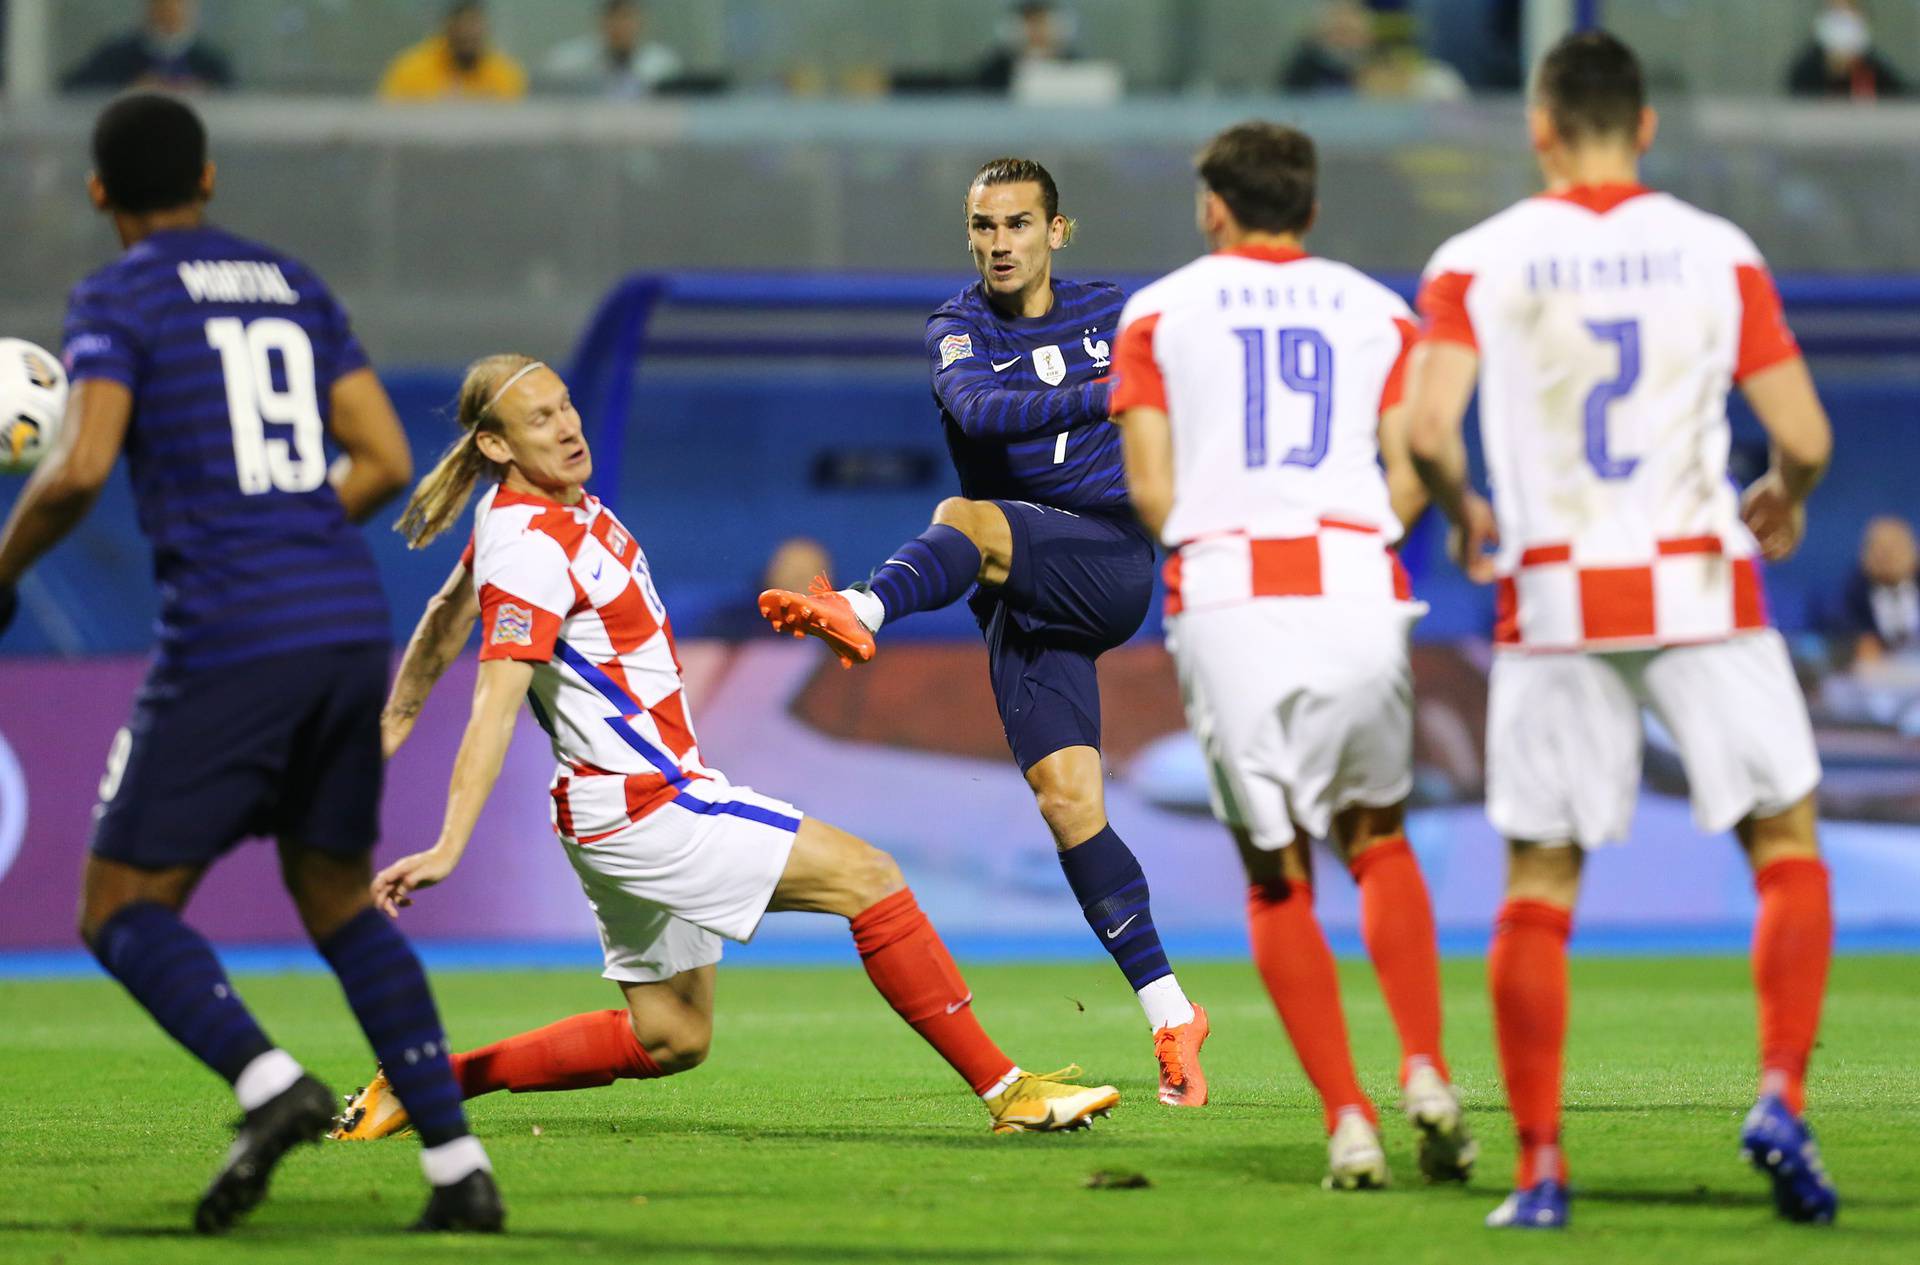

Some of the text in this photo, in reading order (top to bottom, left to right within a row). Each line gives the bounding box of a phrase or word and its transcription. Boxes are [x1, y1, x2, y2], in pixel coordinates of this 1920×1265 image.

[178, 260, 299, 304] MARTIAL
[205, 317, 326, 495] 19
[1232, 329, 1333, 468] 19
[1583, 318, 1641, 479] 2
